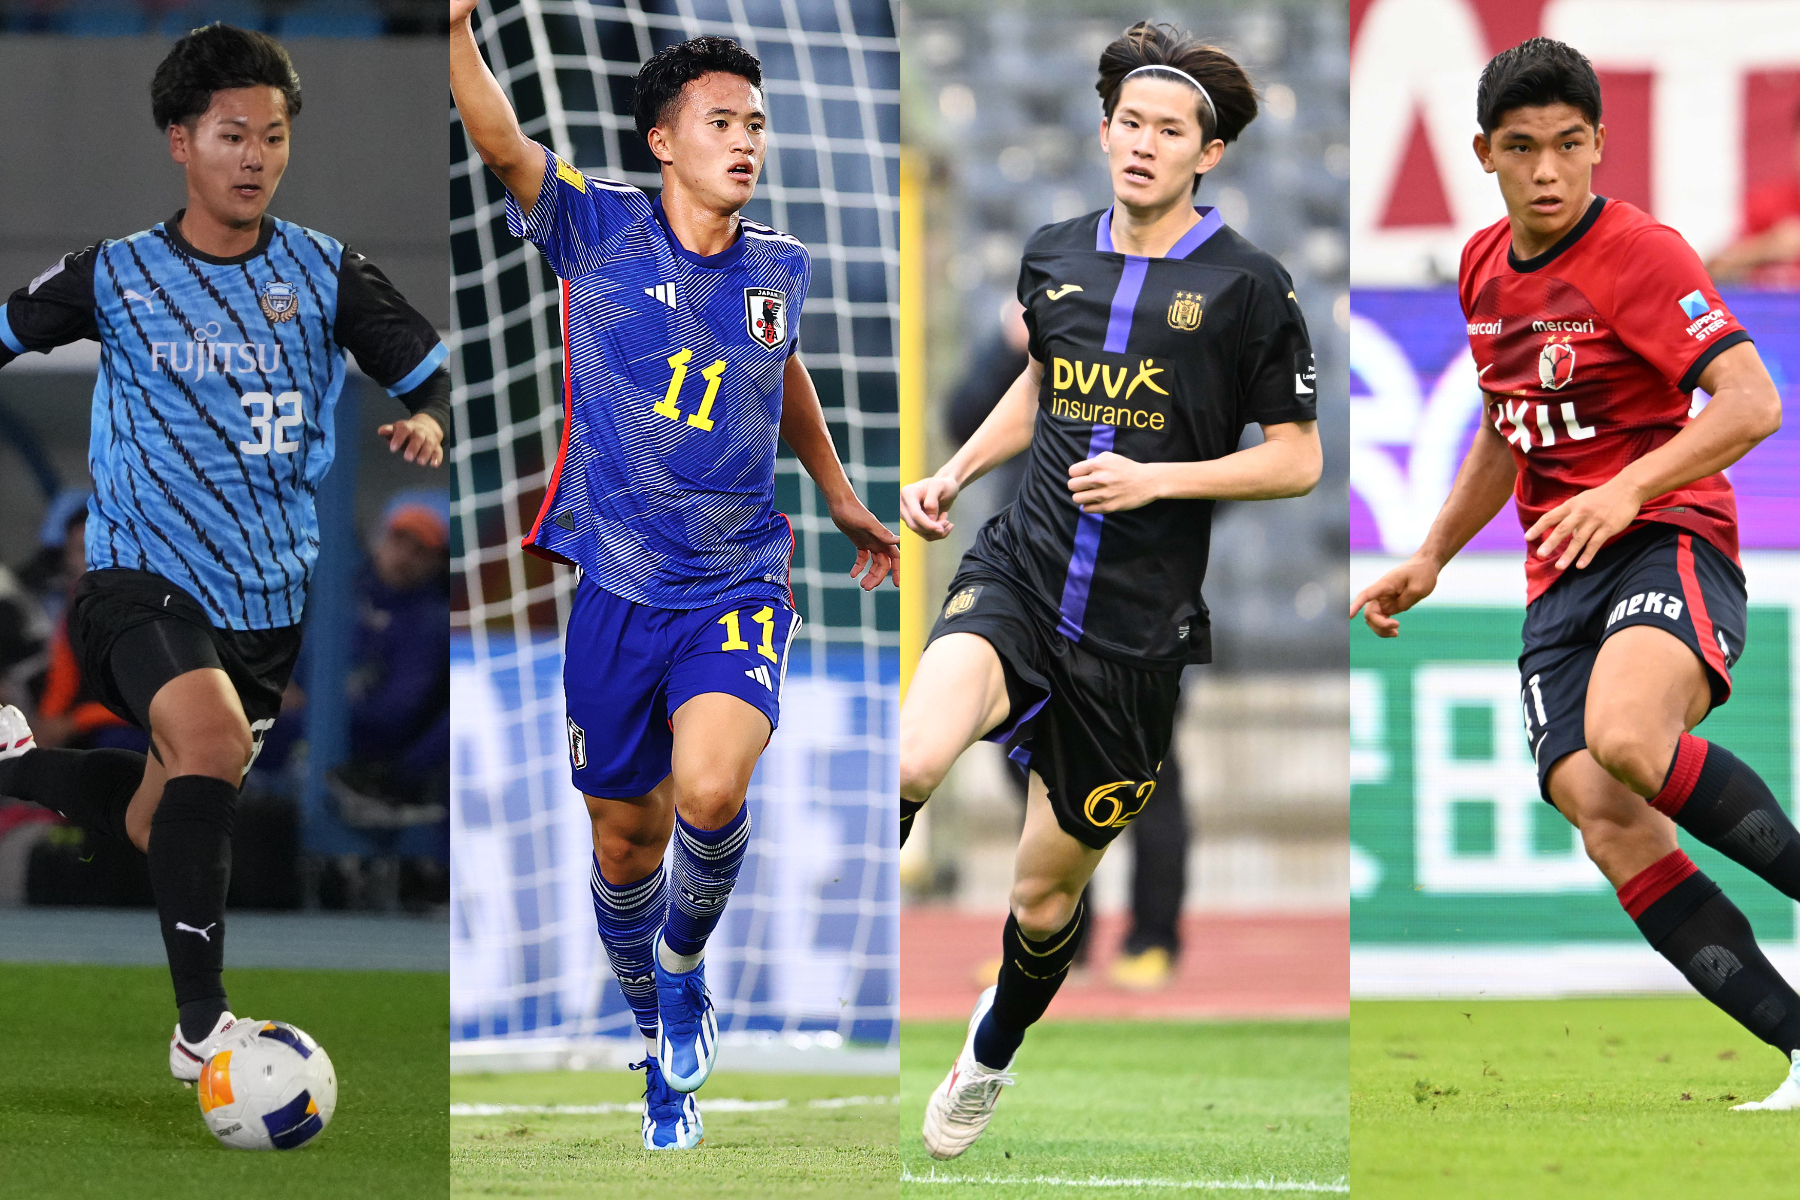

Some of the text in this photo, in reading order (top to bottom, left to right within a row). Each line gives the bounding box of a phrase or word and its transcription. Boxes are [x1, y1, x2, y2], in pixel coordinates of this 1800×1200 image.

[760, 330, 779, 341] JFA
[1466, 319, 1502, 335] mercari
[1532, 318, 1595, 334] mercari
[1685, 309, 1724, 336] NIPPON
[1695, 319, 1728, 341] STEEL
[151, 340, 282, 382] FUJITSU
[652, 347, 727, 432] 11
[239, 391, 303, 455] 32
[1051, 391, 1165, 430] insurance
[716, 605, 778, 665] 11
[1083, 780, 1157, 828] 62
